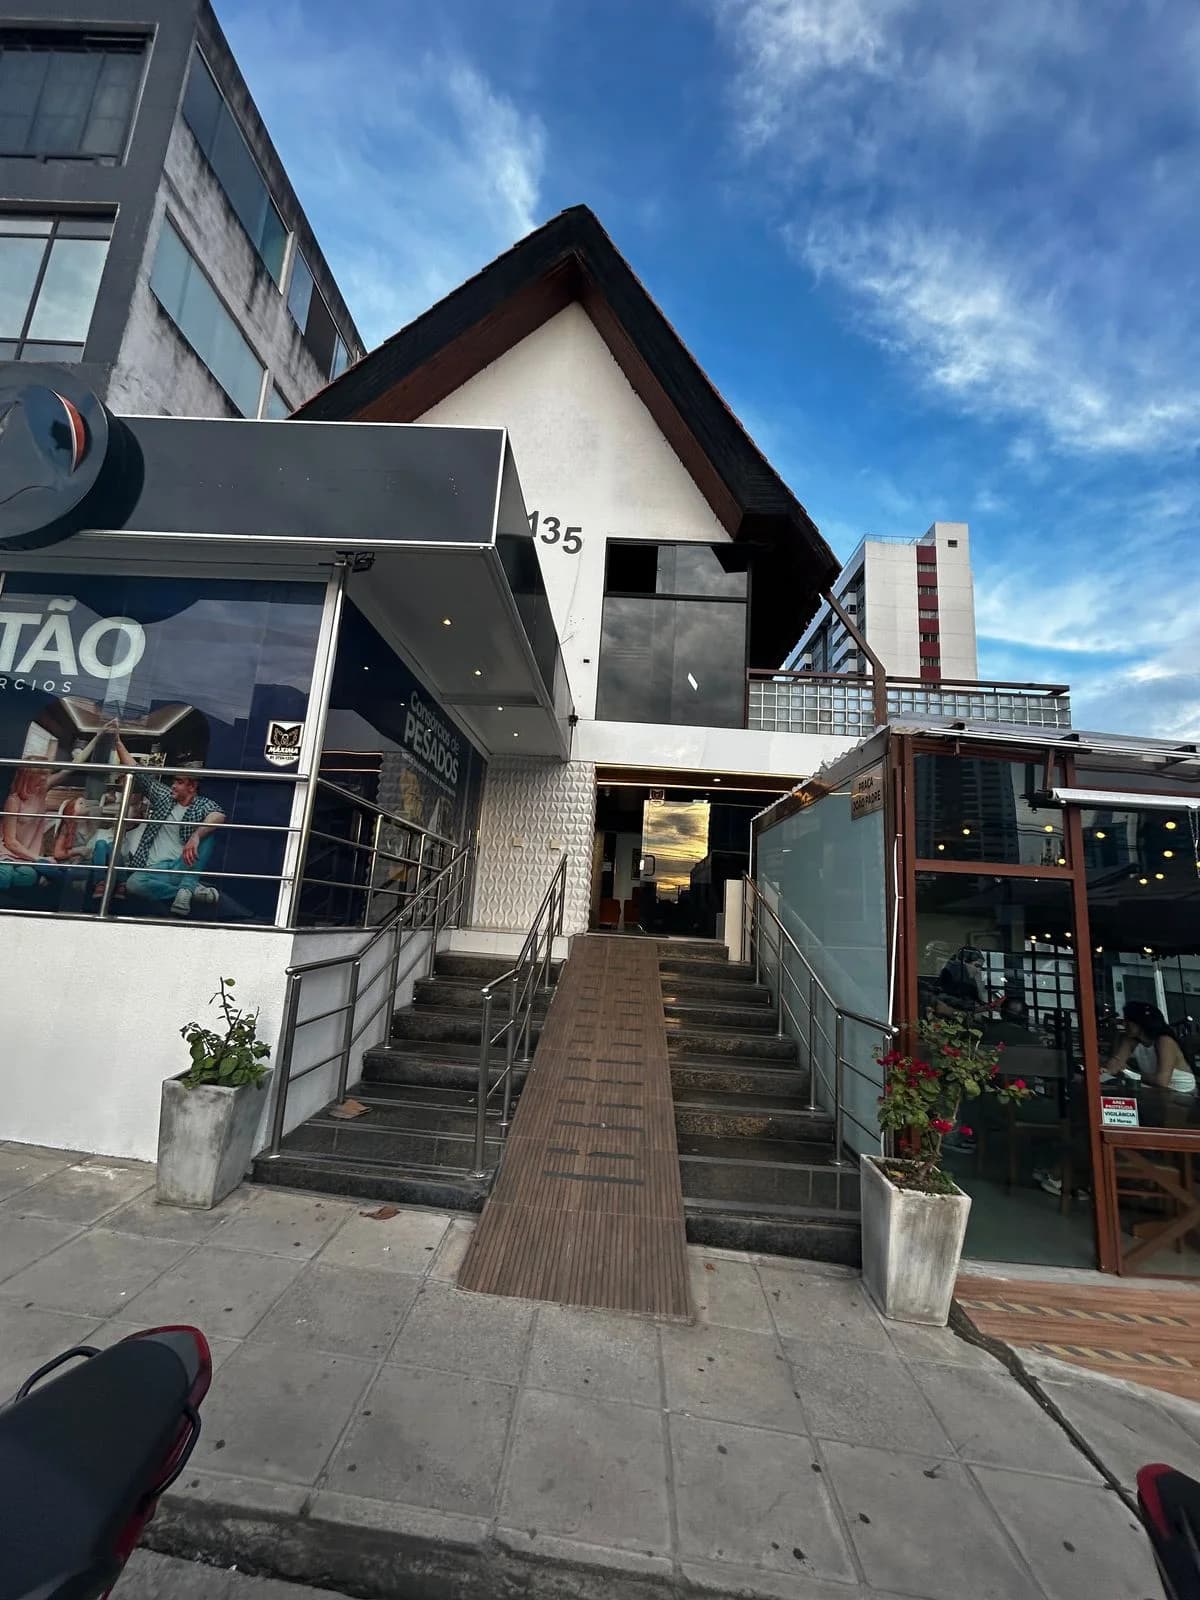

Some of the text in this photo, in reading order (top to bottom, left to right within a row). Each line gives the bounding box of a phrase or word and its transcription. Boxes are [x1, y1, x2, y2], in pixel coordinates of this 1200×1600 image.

[527, 510, 583, 554] 135
[0, 599, 146, 679] TÃO
[404, 711, 460, 785] PESADOS
